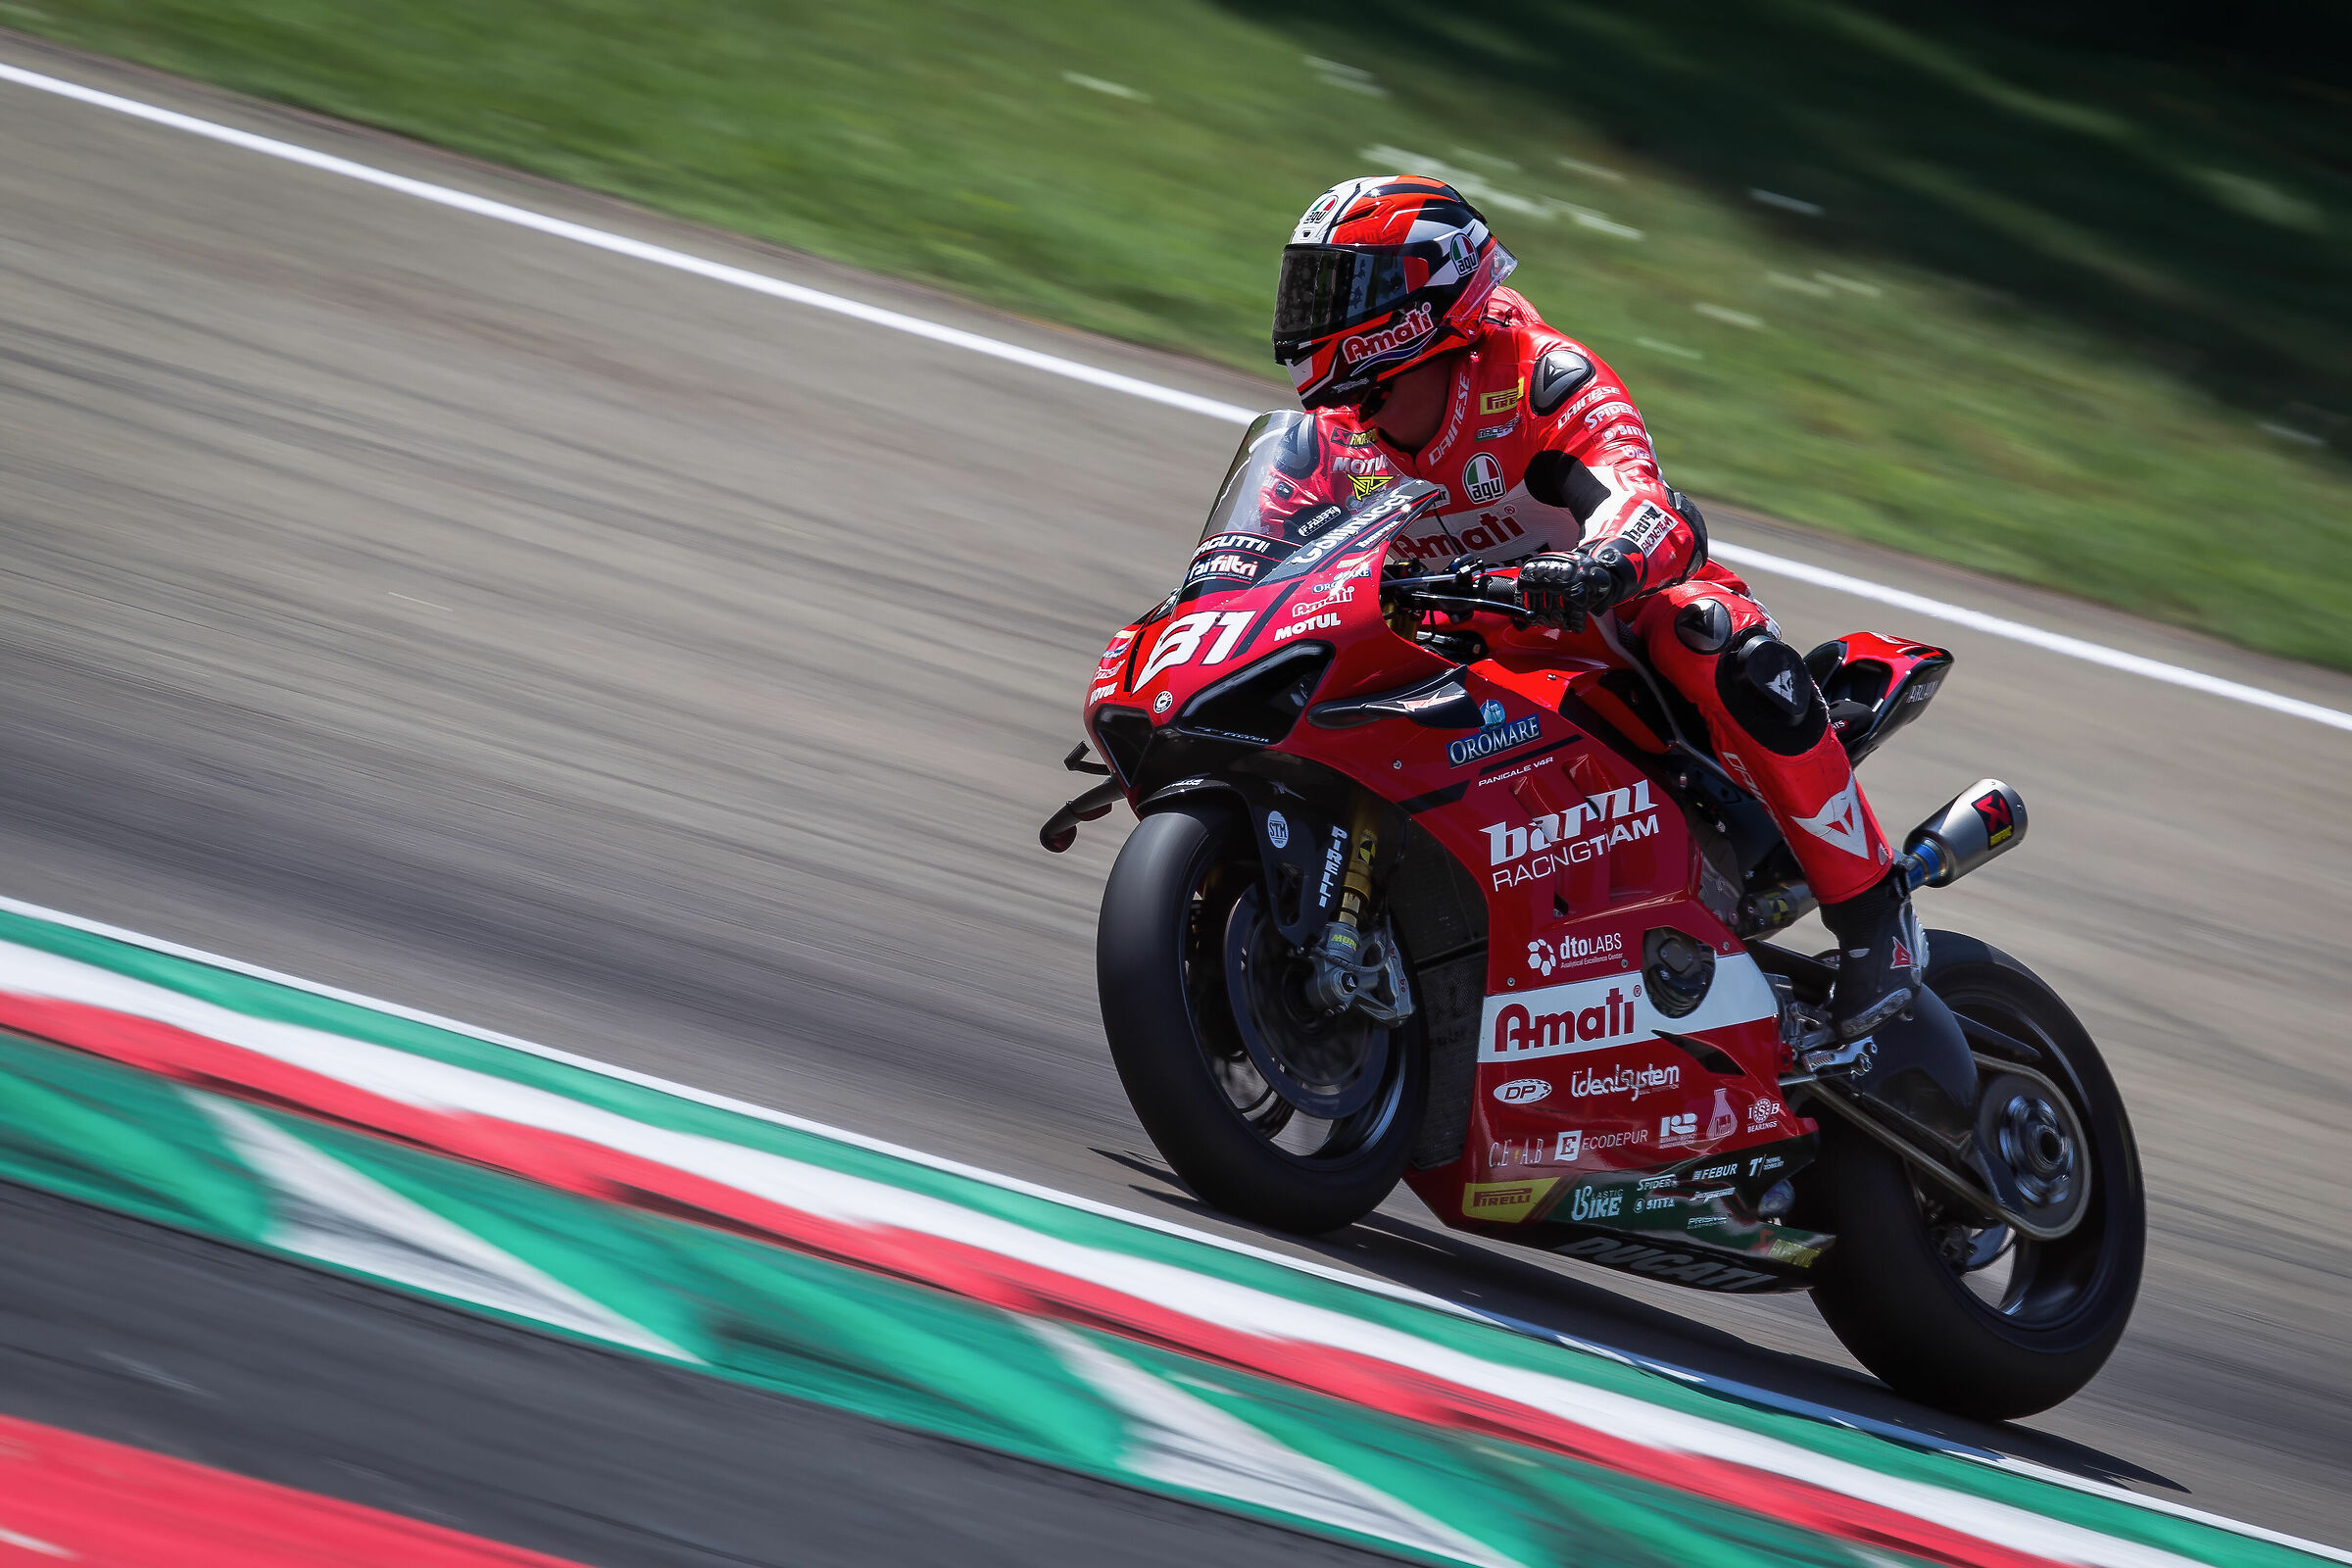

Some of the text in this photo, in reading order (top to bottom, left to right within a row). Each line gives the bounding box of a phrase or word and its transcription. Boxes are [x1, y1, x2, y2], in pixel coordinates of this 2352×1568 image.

[1457, 253, 1477, 272] agv
[1343, 309, 1434, 365] Amati
[1428, 373, 1470, 466] DAINESE
[1472, 480, 1500, 501] agv
[1274, 612, 1342, 641] MOTUL
[1130, 610, 1257, 697] 81
[1449, 716, 1540, 764] OROMARE
[1478, 757, 1553, 786] PANIGALE V4R
[1269, 823, 1288, 838] STM
[1478, 779, 1659, 866] barni
[1318, 825, 1348, 908] PIRELLI
[1560, 932, 1623, 959] dtoLABS
[1494, 988, 1635, 1053] Amati
[1504, 1085, 1537, 1100] DP
[1582, 1129, 1648, 1151] ECODEPUR
[1747, 1120, 1778, 1133] BEARINGS
[1637, 1174, 1673, 1192] SPIDER
[1701, 1163, 1738, 1180] FEBUR
[1473, 1187, 1533, 1207] PIRELLI
[1645, 1198, 1675, 1210] SITTA
[1553, 1237, 1779, 1290] DUCATI
